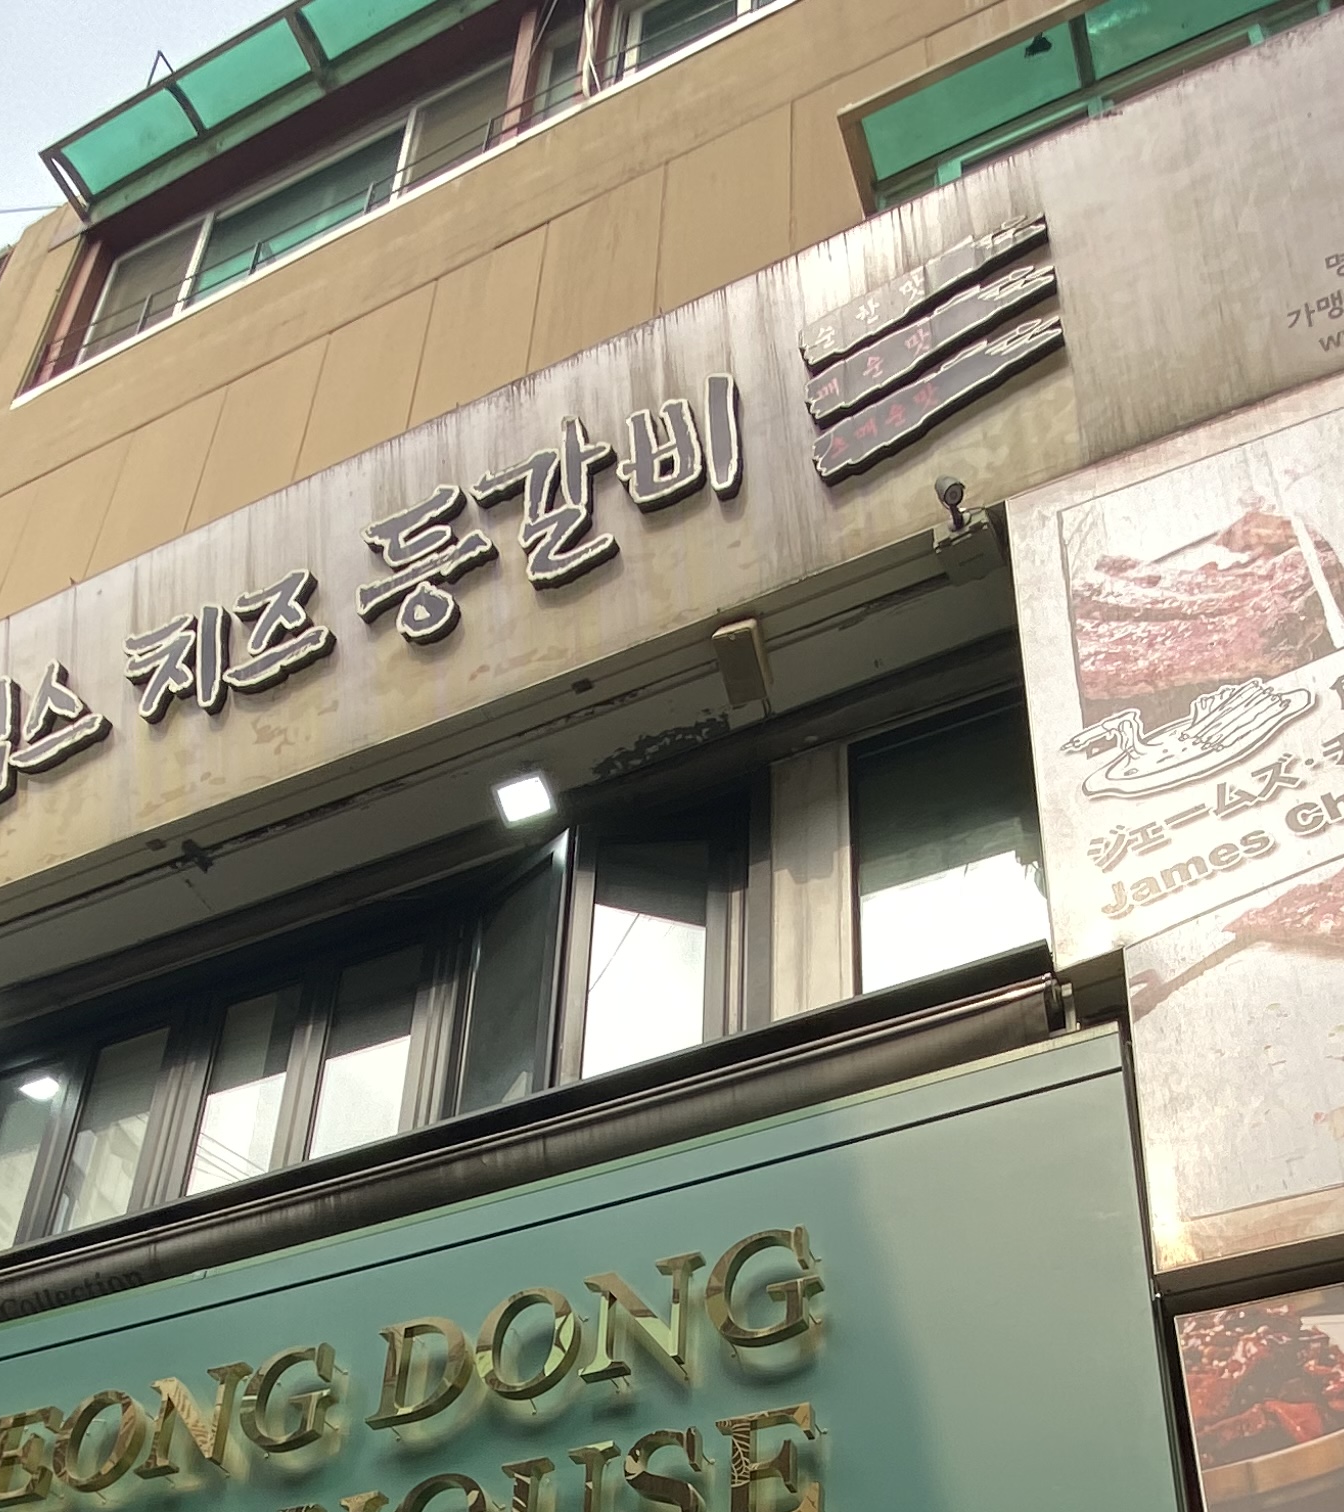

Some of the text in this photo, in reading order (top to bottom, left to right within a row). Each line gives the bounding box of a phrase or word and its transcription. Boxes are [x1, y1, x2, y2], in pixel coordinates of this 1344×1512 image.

[126, 568, 335, 725] 치즈
[356, 373, 743, 645] 등갈비
[1101, 828, 1277, 917] James
[364, 1223, 826, 1432] DONG
